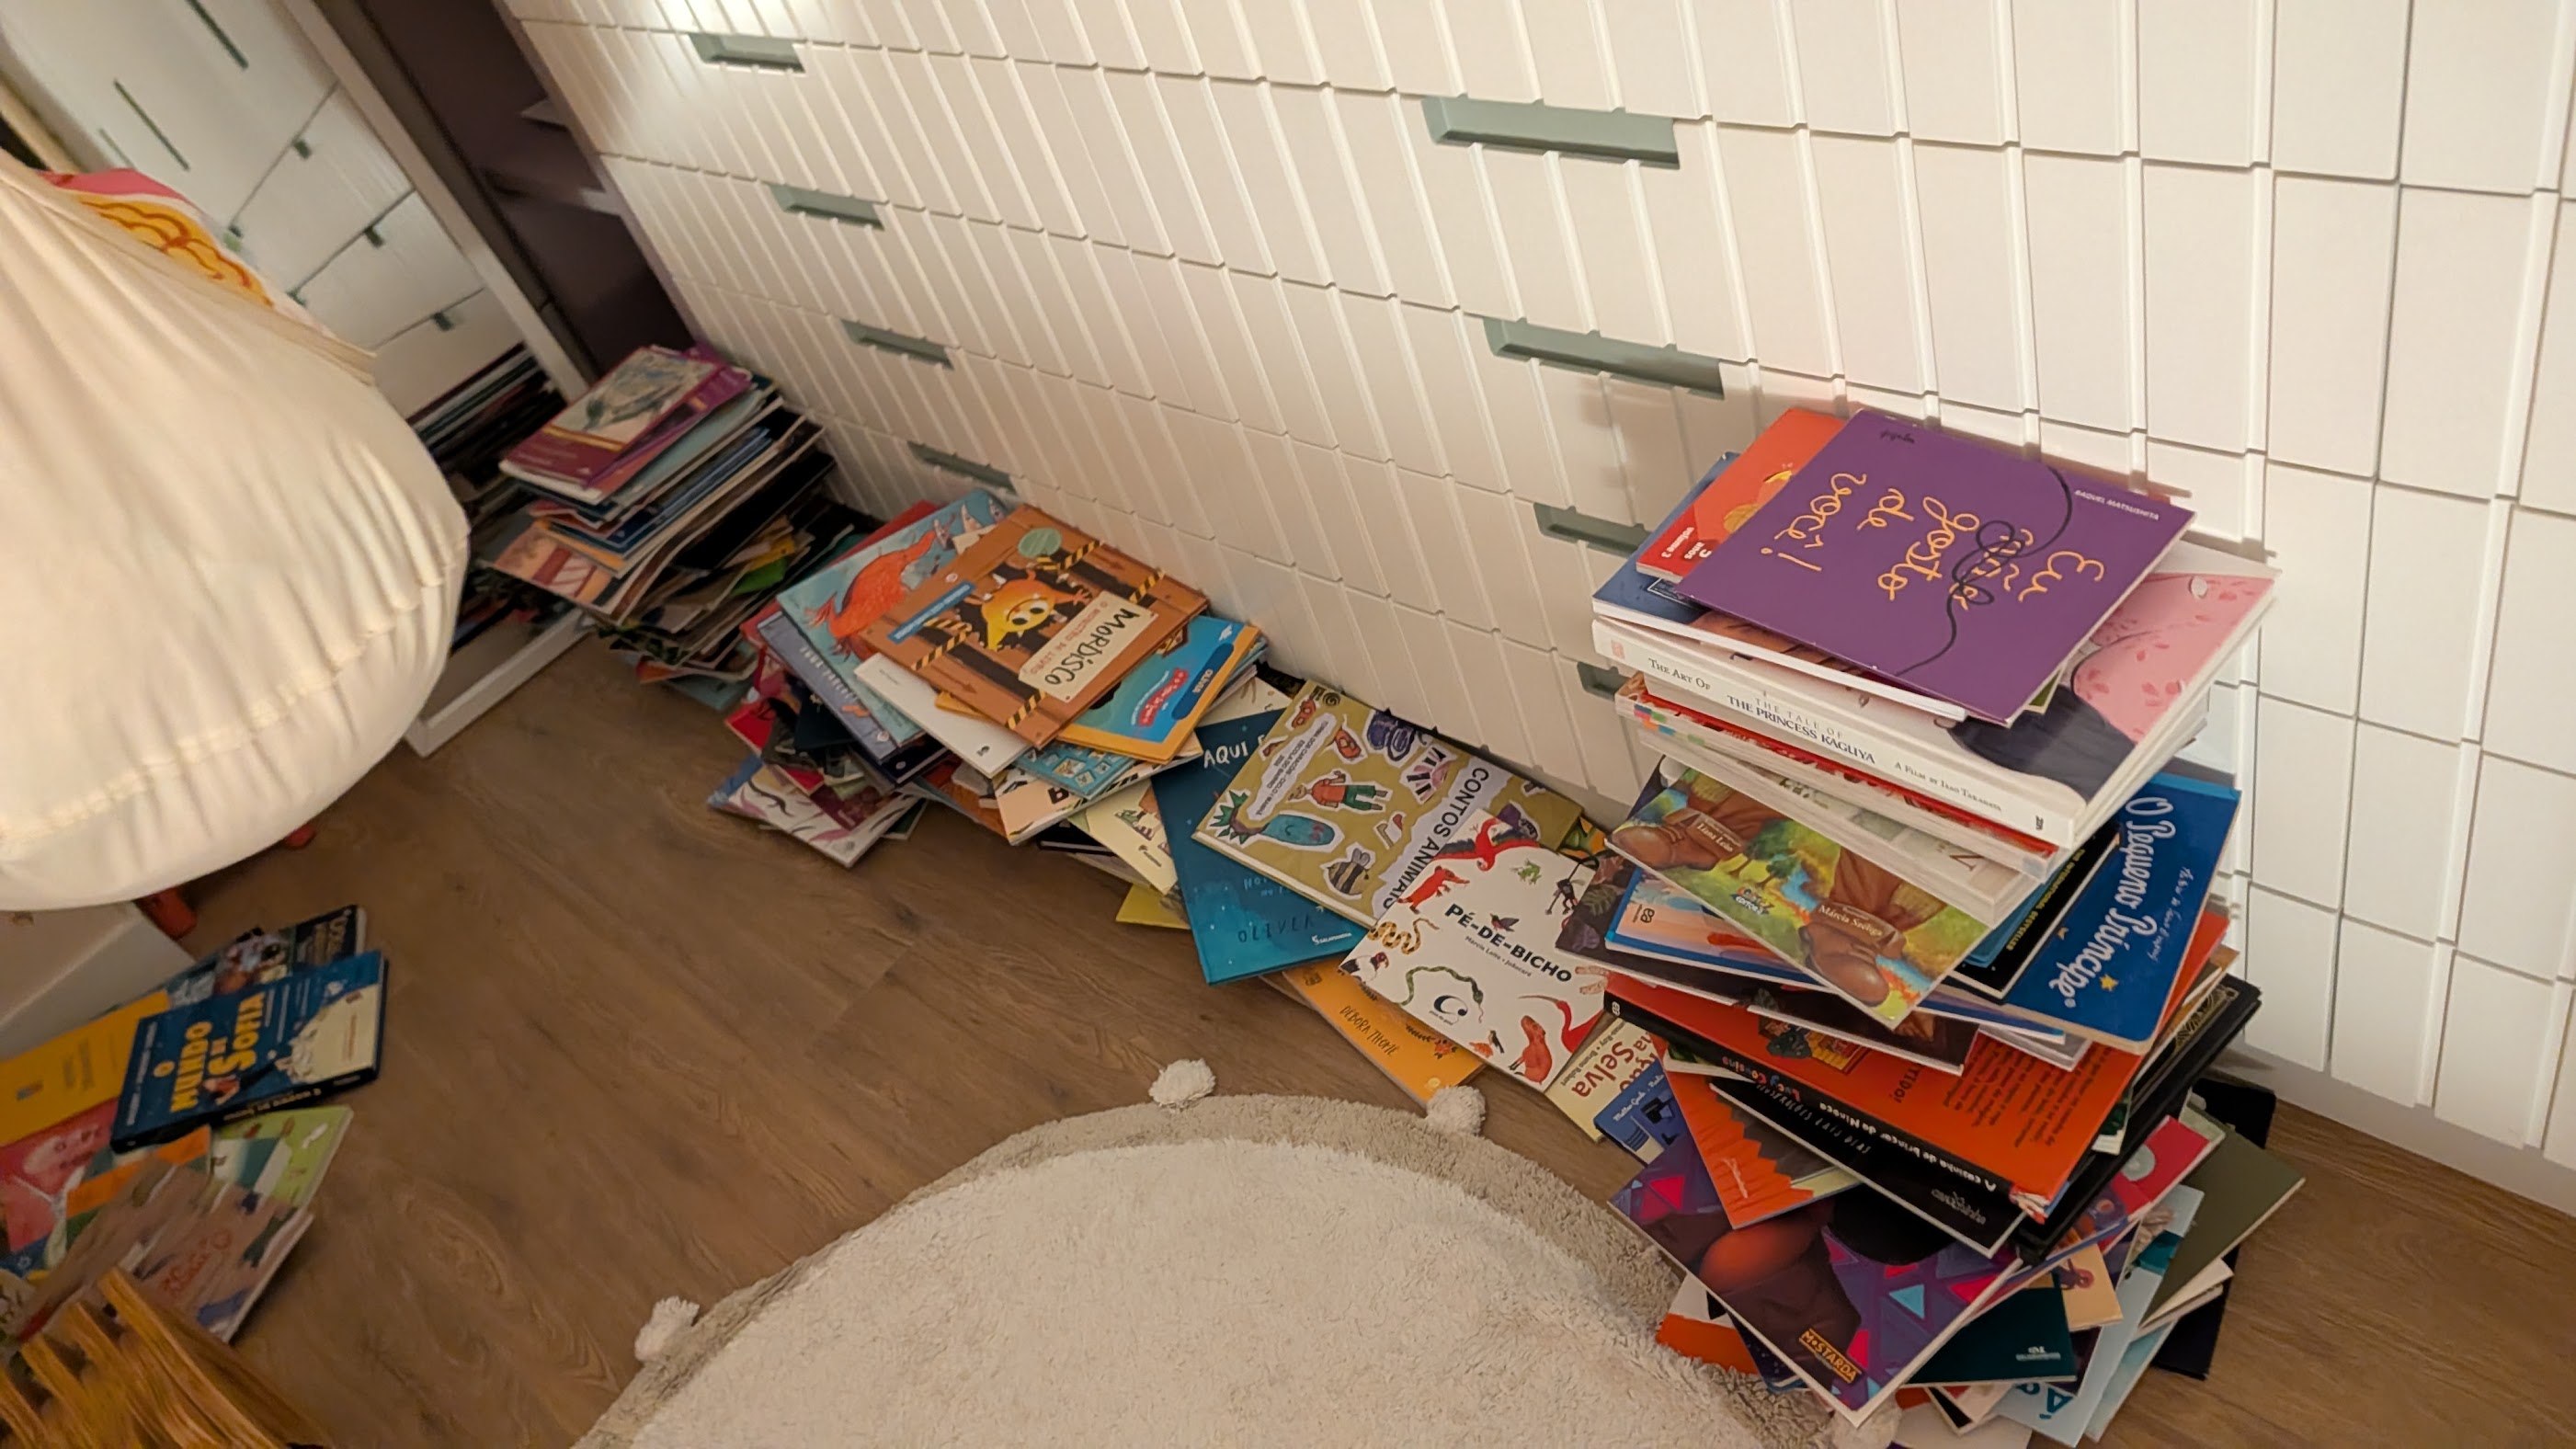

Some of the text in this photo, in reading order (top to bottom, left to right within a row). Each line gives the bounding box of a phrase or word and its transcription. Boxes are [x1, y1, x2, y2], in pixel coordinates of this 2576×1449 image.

[1760, 473, 1867, 572] você!
[1855, 487, 1915, 531] de
[1876, 496, 1980, 601] gosto
[2018, 551, 2105, 602] Eu
[1726, 694, 1876, 765] THE PRINCESS KAGUYA
[1754, 697, 1845, 740] THE TALE OF
[1203, 740, 1249, 770] AQUI
[2125, 796, 2174, 816] O
[1381, 767, 1490, 911] CONTOS ANIMAIS
[2114, 818, 2176, 910] Pequeno
[1443, 903, 1574, 984] PÉ-DE-BICHO
[208, 991, 266, 1076] SOFIA
[153, 1060, 176, 1078] O
[169, 1021, 213, 1112] MUNDO
[1571, 1041, 1636, 1097] Selva
[1938, 1159, 1984, 1188] casinha
[1985, 1179, 1998, 1192] A
